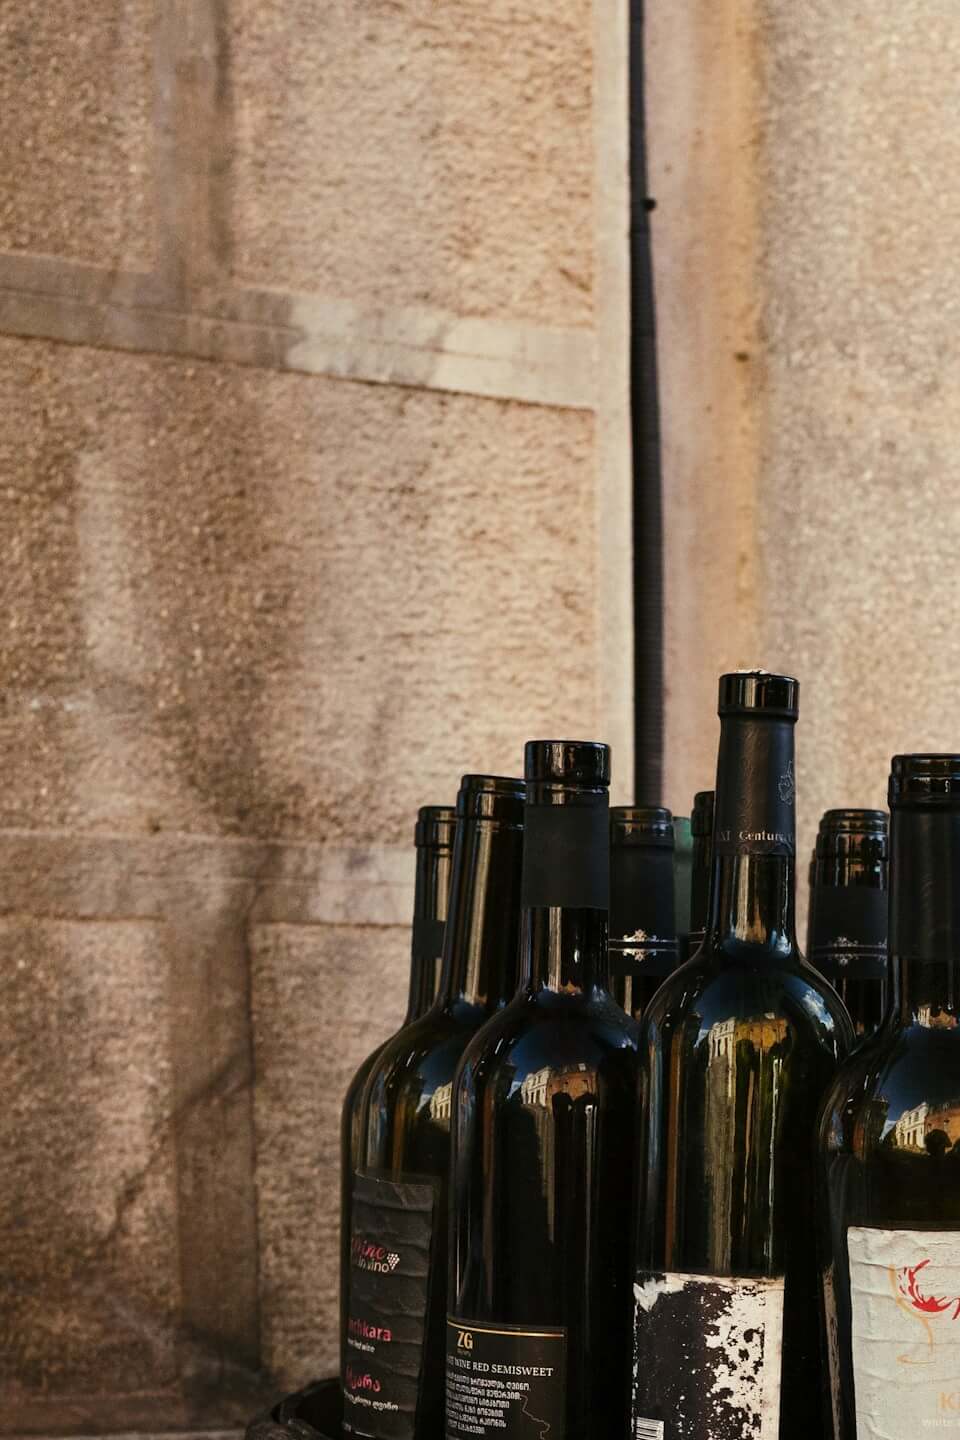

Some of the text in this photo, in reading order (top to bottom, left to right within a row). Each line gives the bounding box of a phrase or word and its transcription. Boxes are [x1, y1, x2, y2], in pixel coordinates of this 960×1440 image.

[456, 1331, 474, 1350] ZG
[472, 1361, 490, 1373] RED
[491, 1363, 554, 1378] SEMISWEET
